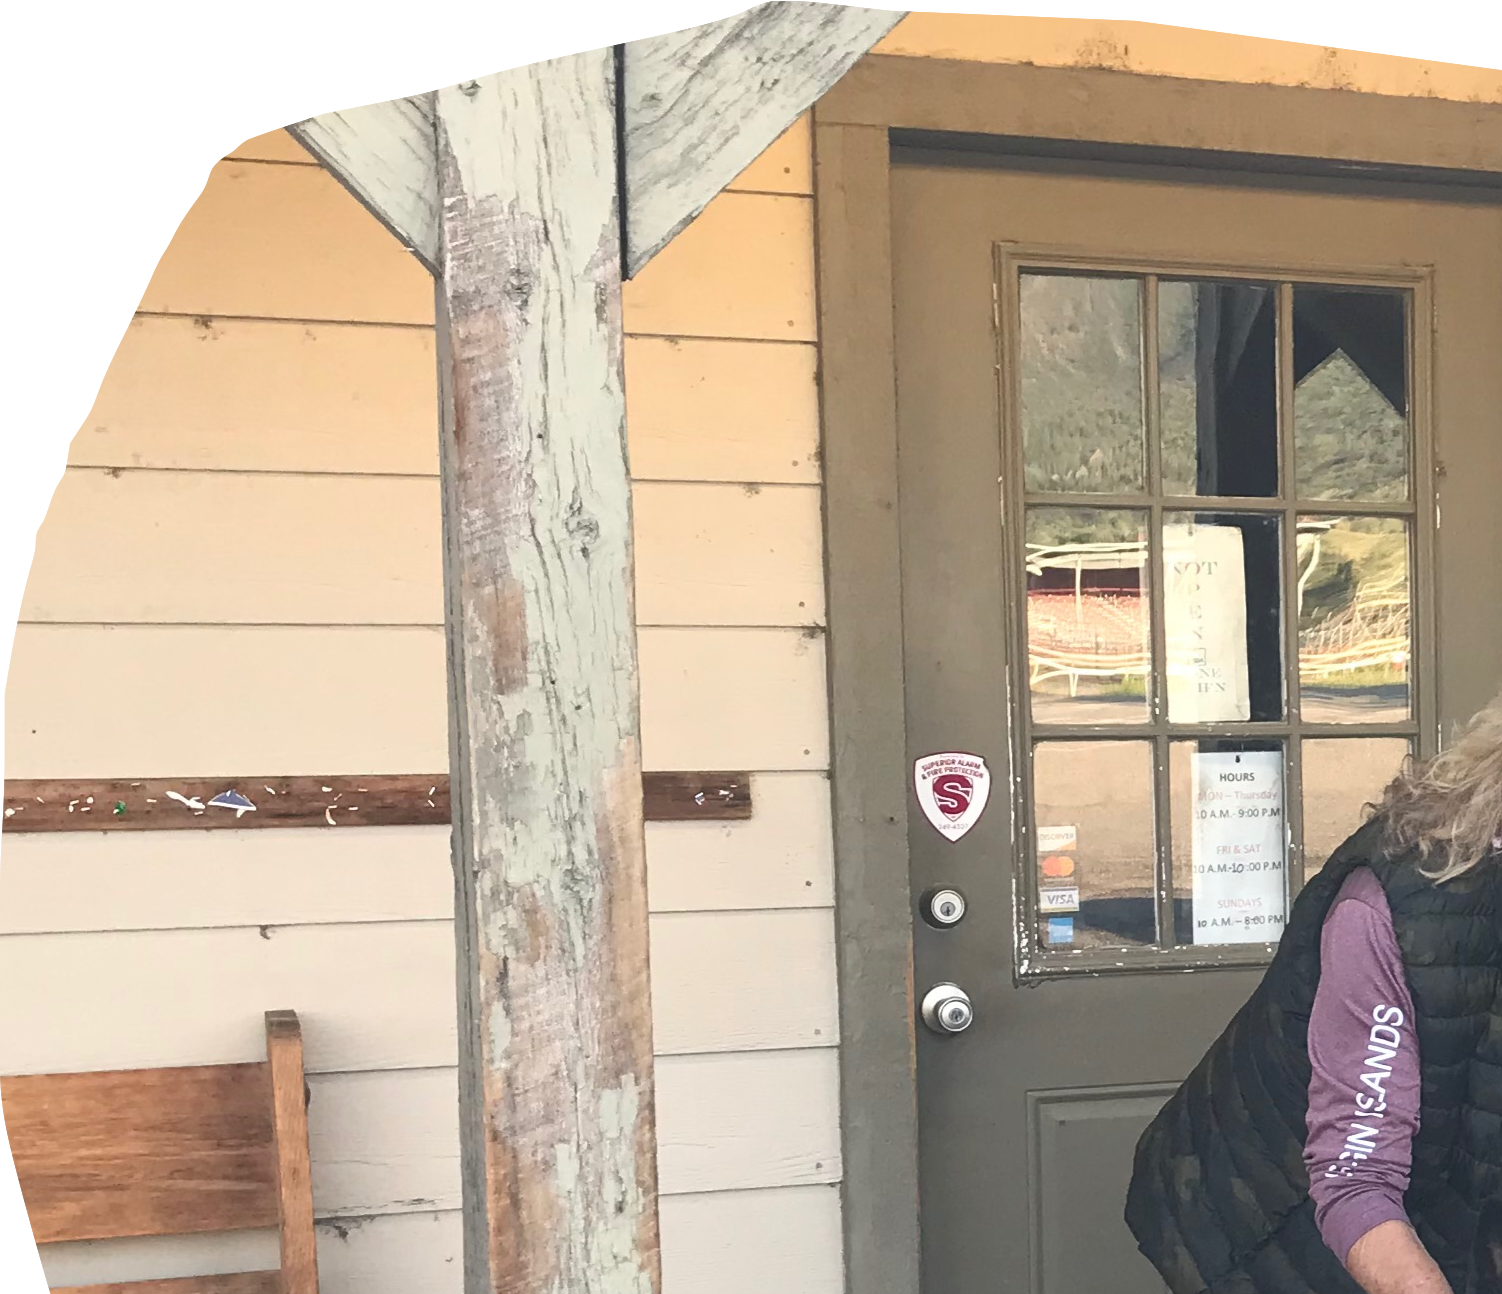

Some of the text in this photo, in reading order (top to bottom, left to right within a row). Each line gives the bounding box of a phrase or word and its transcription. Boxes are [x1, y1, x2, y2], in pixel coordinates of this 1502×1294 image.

[921, 758, 981, 772] SUPERIOR ALARM
[944, 766, 985, 779] PROTECTION
[1219, 772, 1256, 782] HOURS
[1234, 790, 1278, 803] Thursday
[1196, 809, 1207, 820] 10
[1238, 807, 1260, 818] 9:00
[1216, 843, 1262, 855] FRI & SAT
[1046, 894, 1076, 906] VISA
[1217, 897, 1263, 909] SUNDAYS
